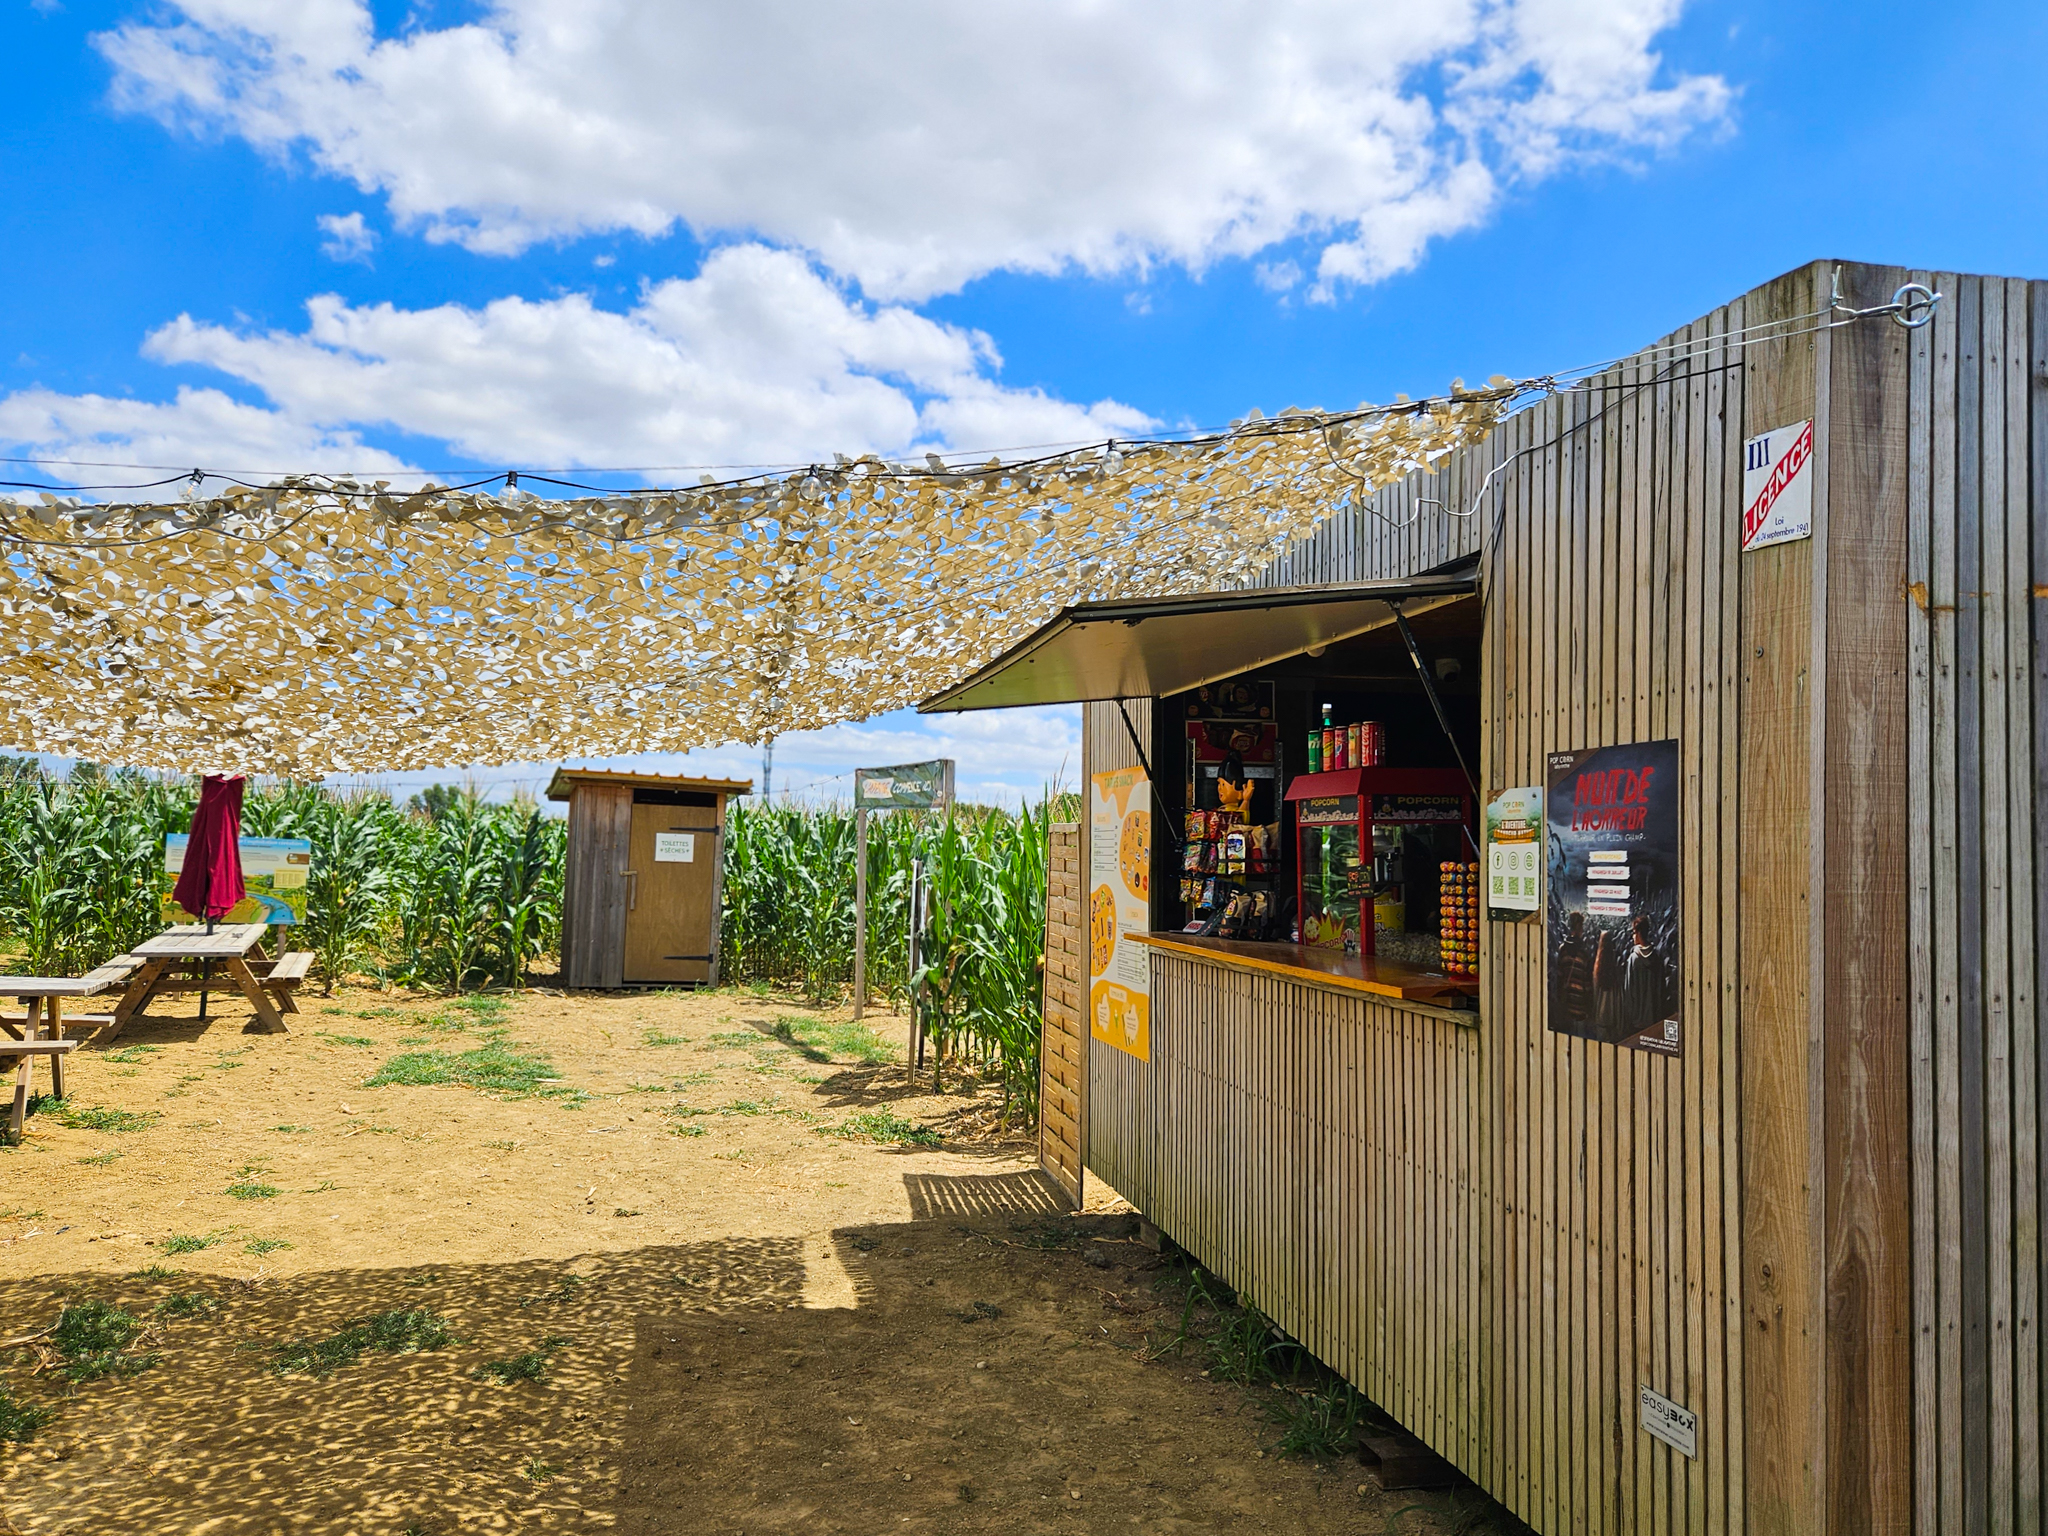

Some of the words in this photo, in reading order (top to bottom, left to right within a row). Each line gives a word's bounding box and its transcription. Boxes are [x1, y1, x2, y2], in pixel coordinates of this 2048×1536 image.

[1747, 438, 1770, 471] III
[1744, 428, 1810, 542] LICENCE
[1775, 516, 1784, 526] Loi
[1767, 527, 1795, 540] septembre
[1574, 770, 1625, 807] NUIT
[1623, 766, 1655, 805] DE
[1311, 798, 1339, 807] POPCORN
[1397, 796, 1458, 805] POPCORN
[1572, 807, 1647, 832] L'HORREUR
